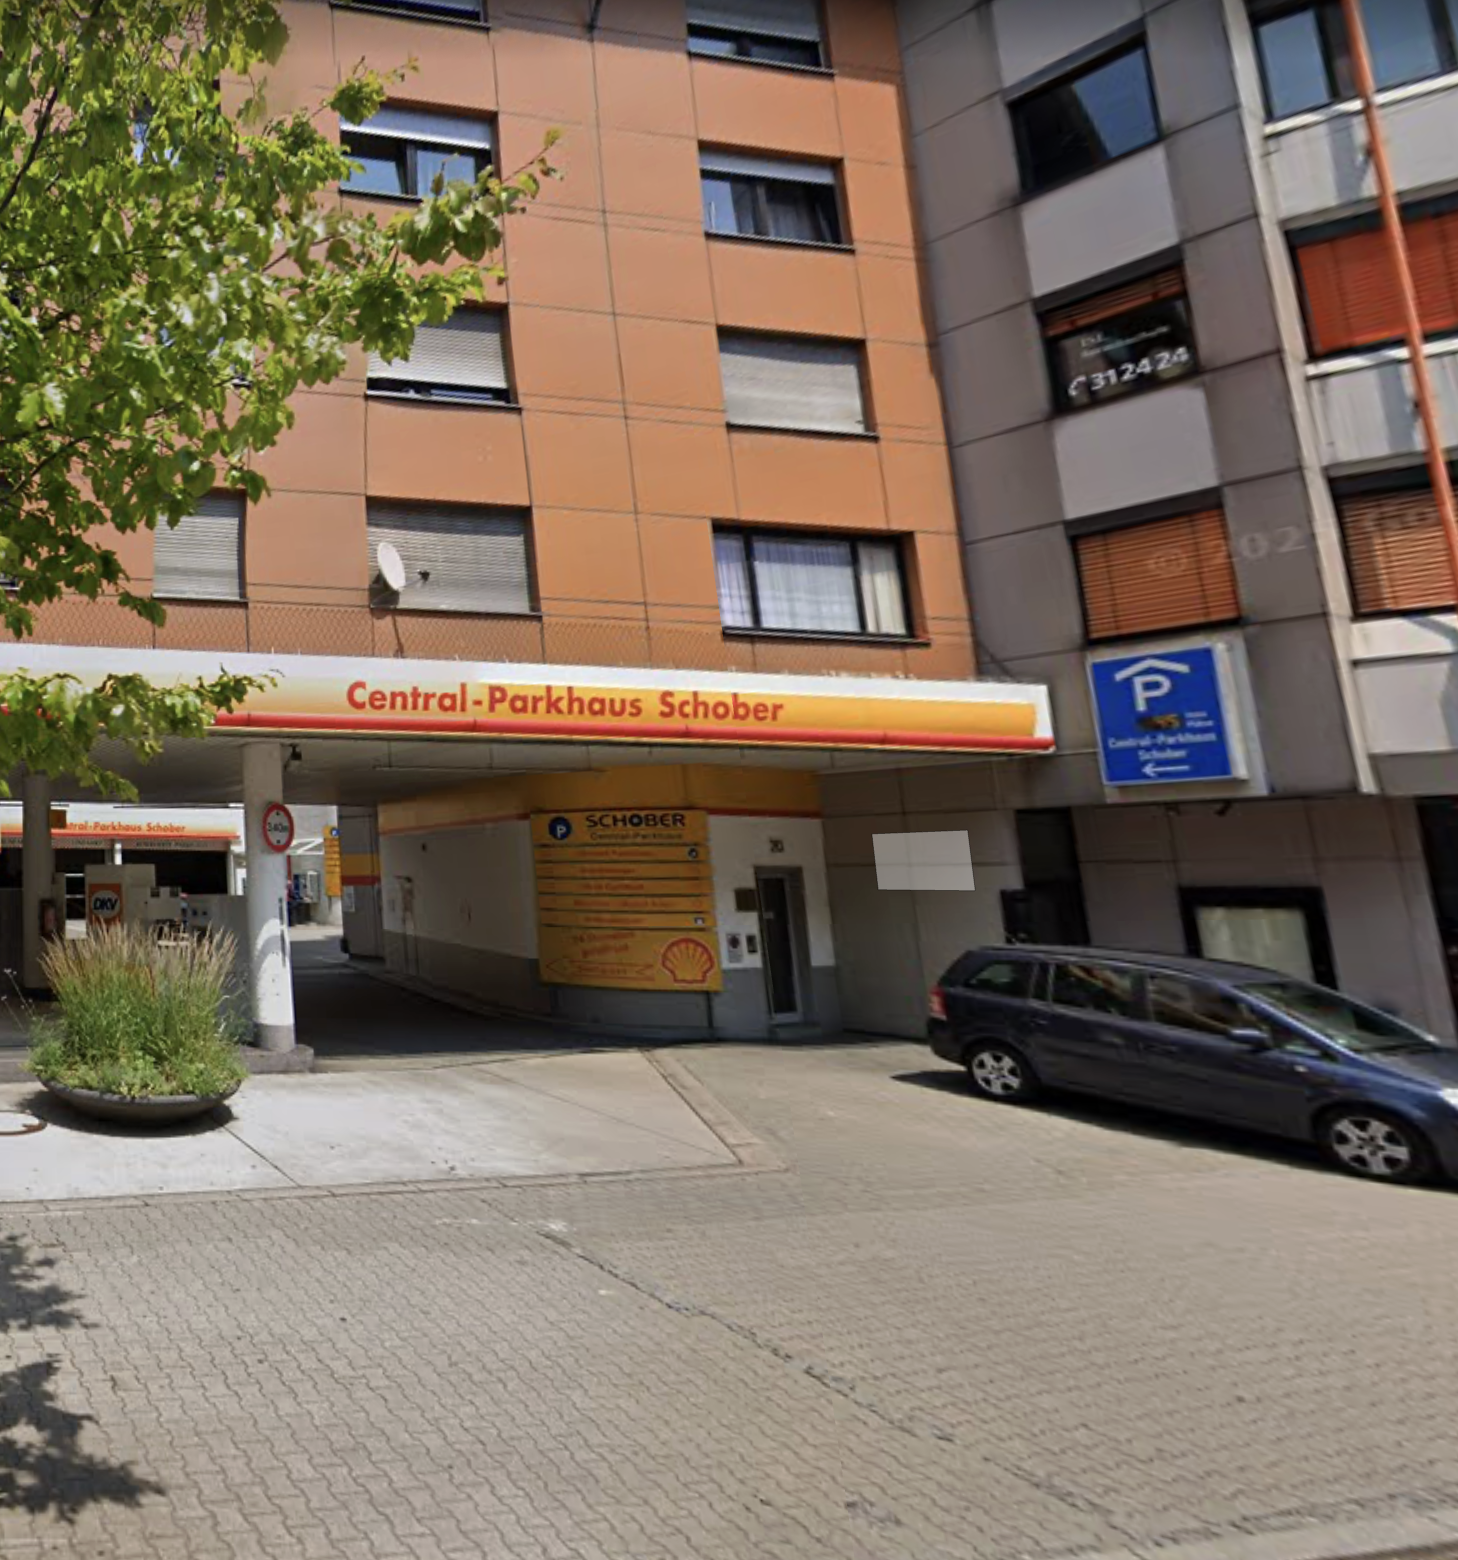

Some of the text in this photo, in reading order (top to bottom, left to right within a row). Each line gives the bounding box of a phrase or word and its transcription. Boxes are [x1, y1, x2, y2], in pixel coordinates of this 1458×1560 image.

[1133, 673, 1172, 712] P
[346, 680, 784, 722] Central-Parkhaus Schober
[146, 822, 186, 833] Schober
[586, 813, 686, 828] SCHOBER
[93, 897, 119, 907] DKV
